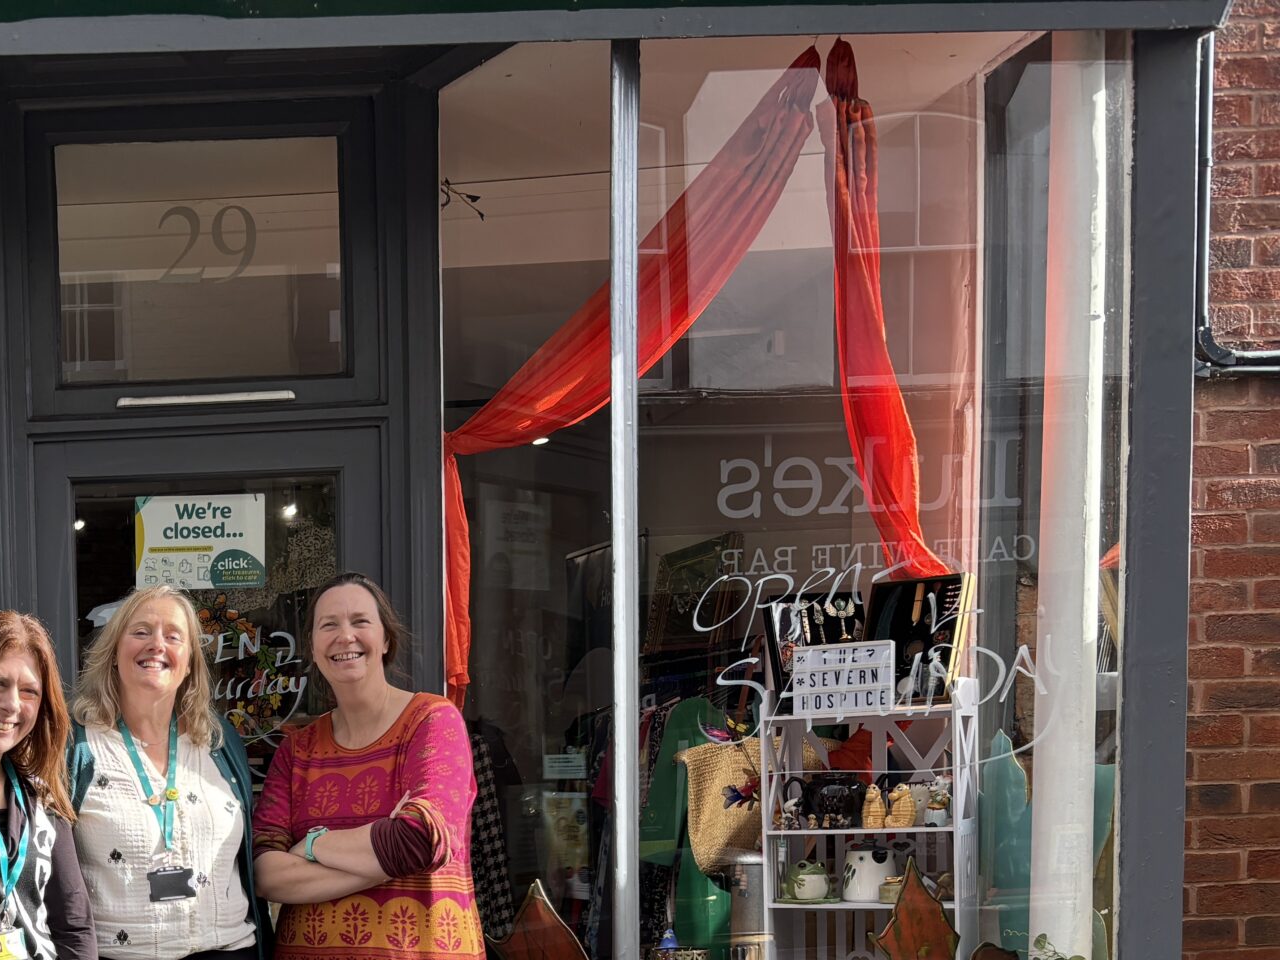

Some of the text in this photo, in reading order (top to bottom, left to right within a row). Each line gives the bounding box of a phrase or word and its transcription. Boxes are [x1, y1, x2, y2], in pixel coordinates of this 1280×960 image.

[158, 205, 257, 284] 29
[175, 502, 232, 520] We're
[162, 522, 244, 540] closed...
[217, 557, 248, 570] click
[269, 630, 303, 668] 2
[822, 648, 858, 665] THE
[809, 668, 878, 688] SEVERN
[801, 690, 886, 710] HOSPICE
